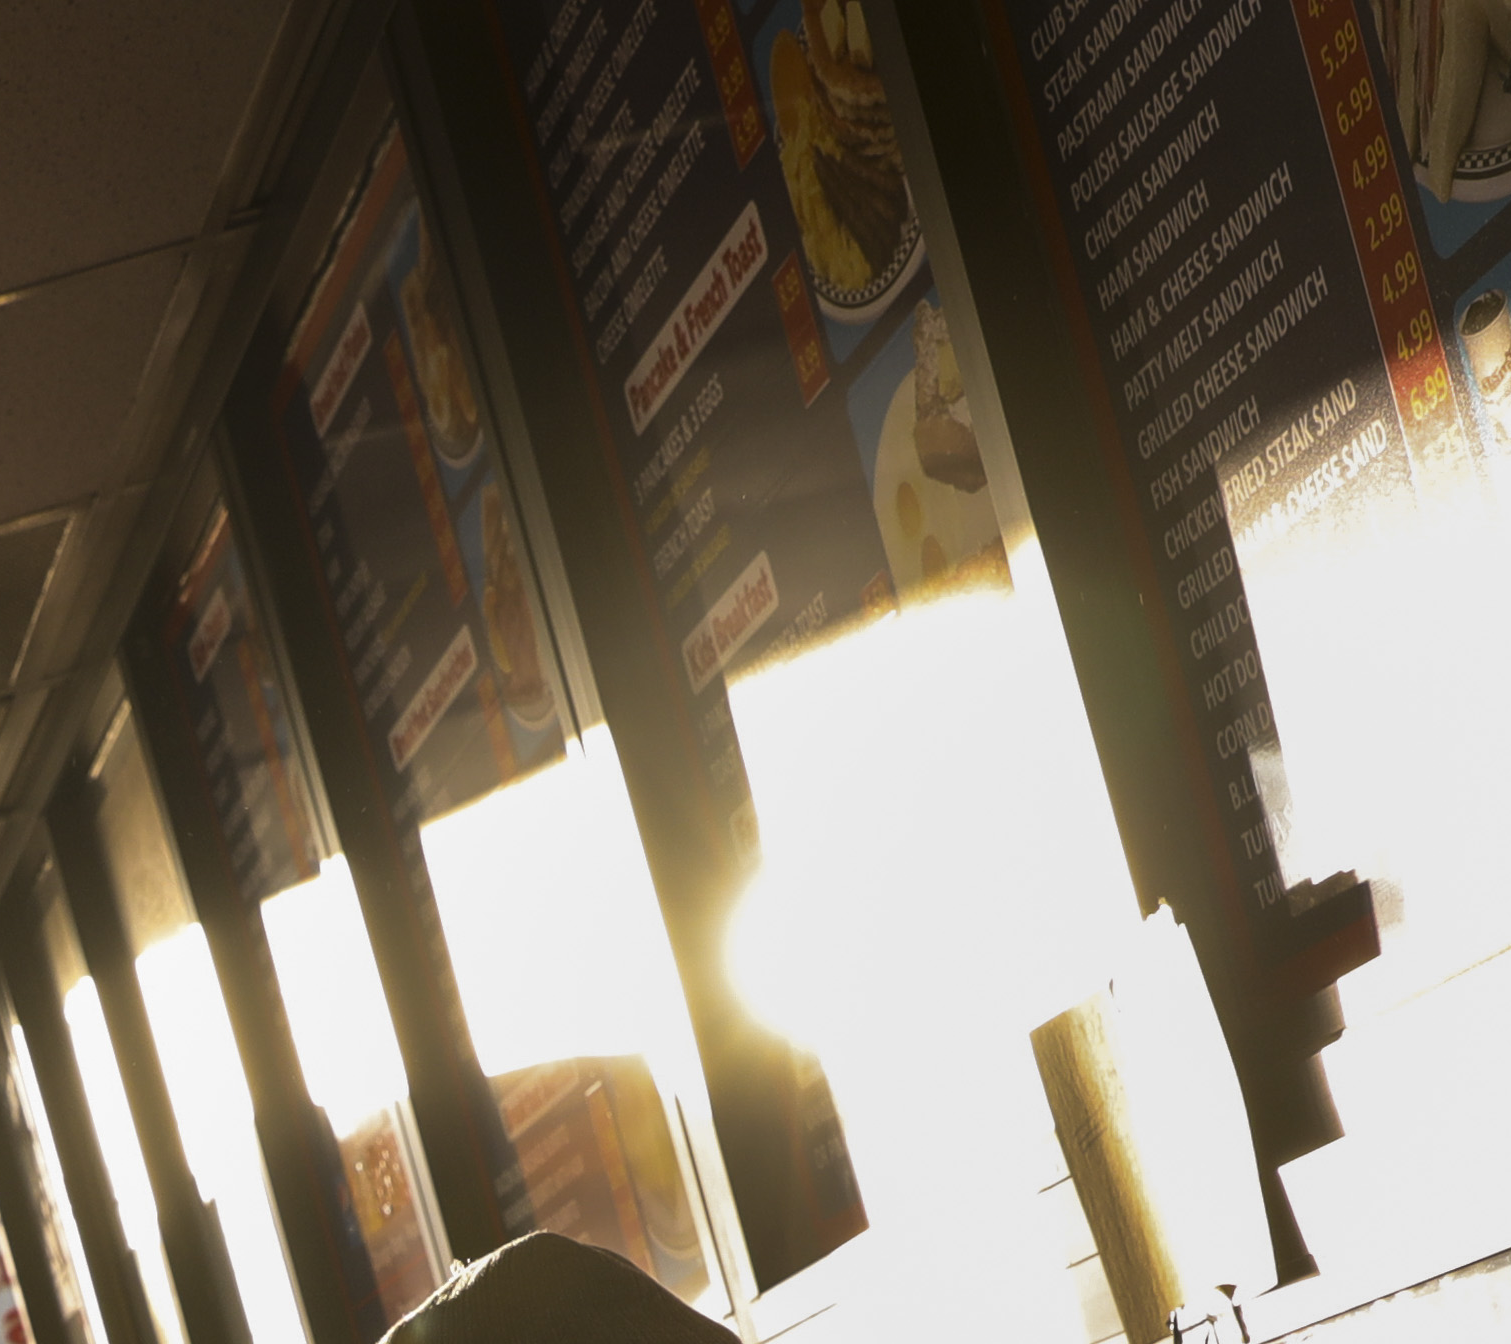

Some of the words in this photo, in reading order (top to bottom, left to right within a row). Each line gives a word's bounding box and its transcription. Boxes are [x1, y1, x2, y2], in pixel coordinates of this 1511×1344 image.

[583, 61, 616, 128] CHEESE
[611, 0, 657, 79] OMELETTE
[1031, 5, 1066, 61] CLUB
[1043, 46, 1087, 113] STEAK
[1320, 19, 1358, 79] 5.99
[623, 129, 657, 196] CHEESE
[652, 57, 701, 147] OMELETTE
[1057, 67, 1127, 163] PASTRAMI
[1070, 141, 1120, 212] POLISH
[1118, 71, 1184, 161] SAUSAGE
[1181, 0, 1262, 92] SANDWICH
[1337, 77, 1373, 135] 6.99
[1352, 135, 1388, 191] 4.99
[628, 189, 662, 253] CHEESE
[658, 120, 707, 208] OMELETTE
[1084, 182, 1144, 261] CHICKEN
[1141, 99, 1221, 202] SANDWICH
[1365, 193, 1403, 252] 2.99
[1097, 256, 1135, 312] HAM
[1132, 179, 1210, 278] SANDWICH
[1110, 307, 1148, 362] HAM
[1146, 295, 1162, 328] &
[1160, 241, 1214, 313] CHEESE
[1211, 162, 1294, 264] SANDWICH
[1381, 251, 1418, 304] 4.99
[597, 304, 628, 365] CHEESE
[623, 244, 669, 324] OMELETTE
[627, 343, 680, 426] Pancake
[673, 321, 690, 363] &
[683, 267, 729, 346] French
[722, 218, 764, 291] Toast
[1123, 351, 1165, 413] PATTY
[1165, 315, 1204, 374] MELT
[1202, 239, 1284, 339] SANDWICH
[1137, 391, 1194, 460] GRILLED
[1193, 341, 1247, 411] CHEESE
[1245, 264, 1329, 364] SANDWICH
[1396, 309, 1433, 361] 4.99
[1410, 366, 1448, 421] 6.99
[1149, 458, 1184, 512] FISH
[1181, 394, 1261, 485] SANDWICH
[1163, 487, 1226, 561] CHICKEN
[1224, 455, 1266, 513] FRIED
[1264, 413, 1315, 476] STEAK
[1312, 377, 1357, 437] SAND
[1176, 545, 1234, 610] GRILLED
[1341, 417, 1387, 480] SAND
[685, 632, 718, 681] Kids
[710, 565, 774, 653] Breakfast
[1189, 611, 1228, 660] CHILI
[1202, 659, 1233, 711] HOT
[1216, 707, 1259, 760] CORN
